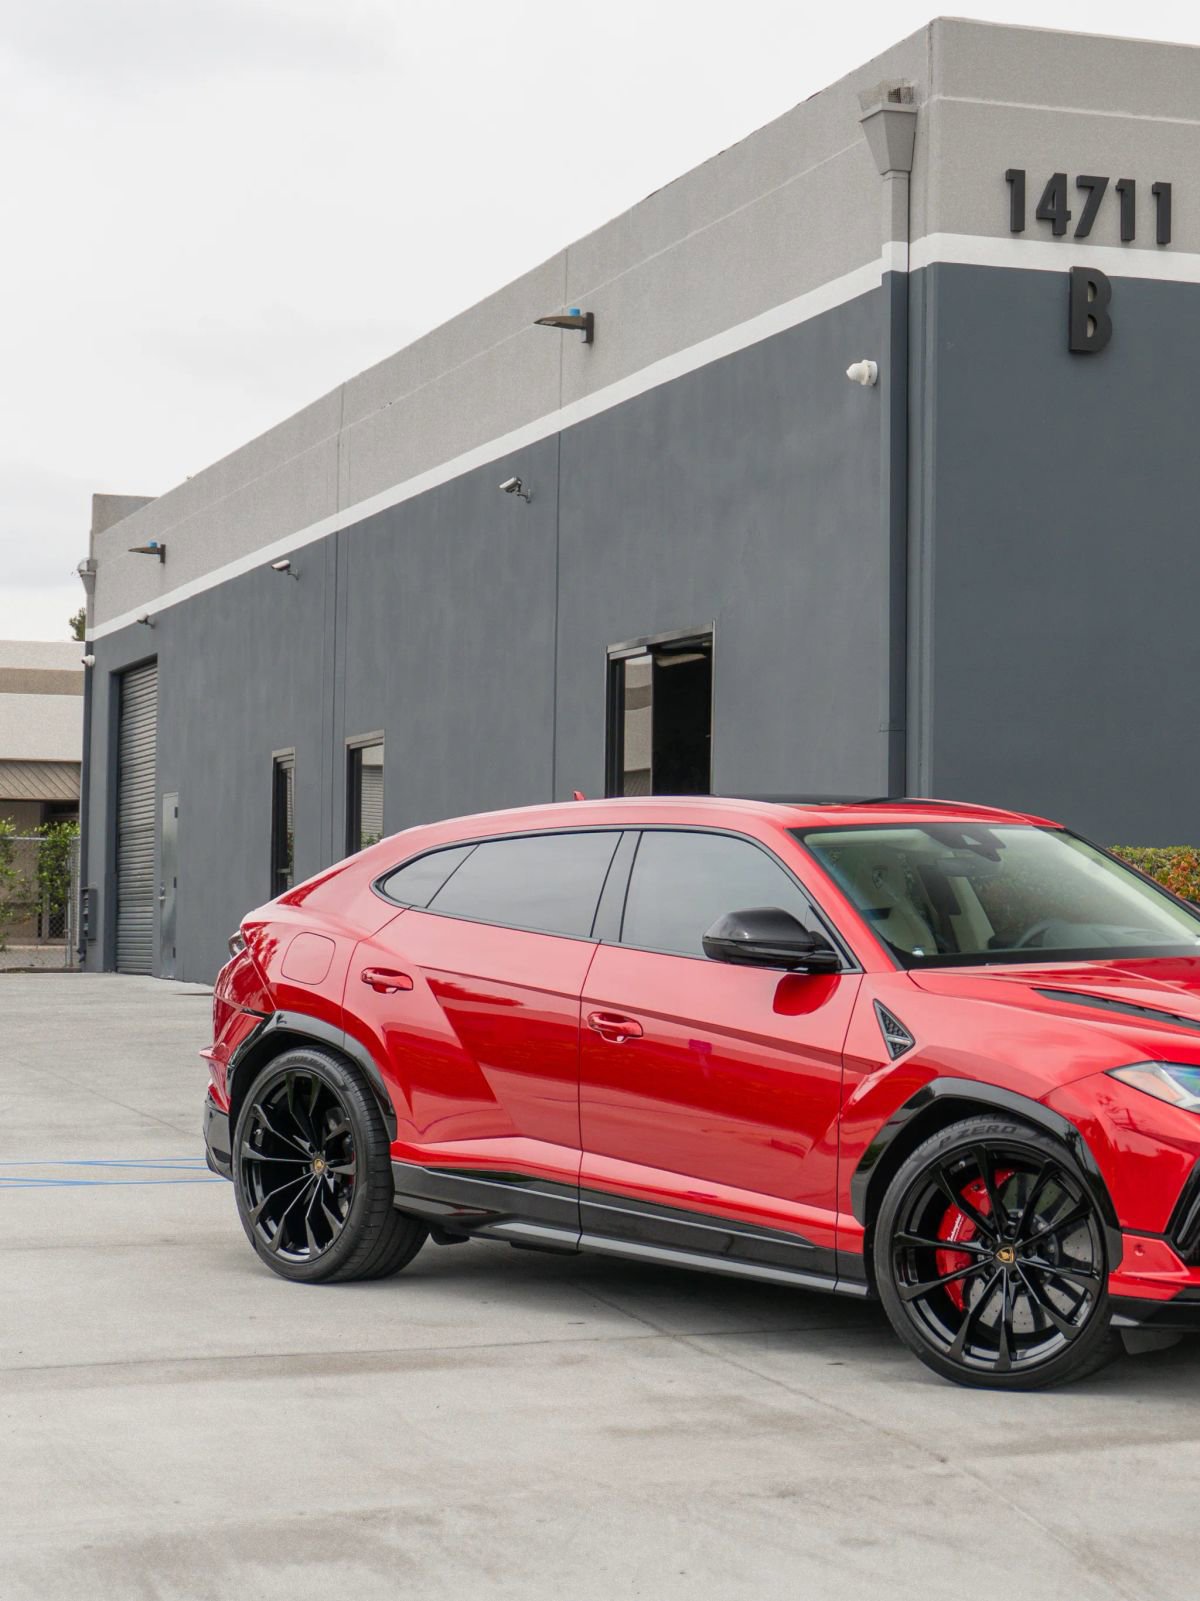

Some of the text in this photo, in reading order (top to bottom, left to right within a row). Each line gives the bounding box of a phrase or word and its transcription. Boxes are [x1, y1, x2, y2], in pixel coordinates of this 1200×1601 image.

[1006, 168, 1172, 244] 14711
[1068, 265, 1113, 353] B
[956, 1124, 1018, 1139] ZERO
